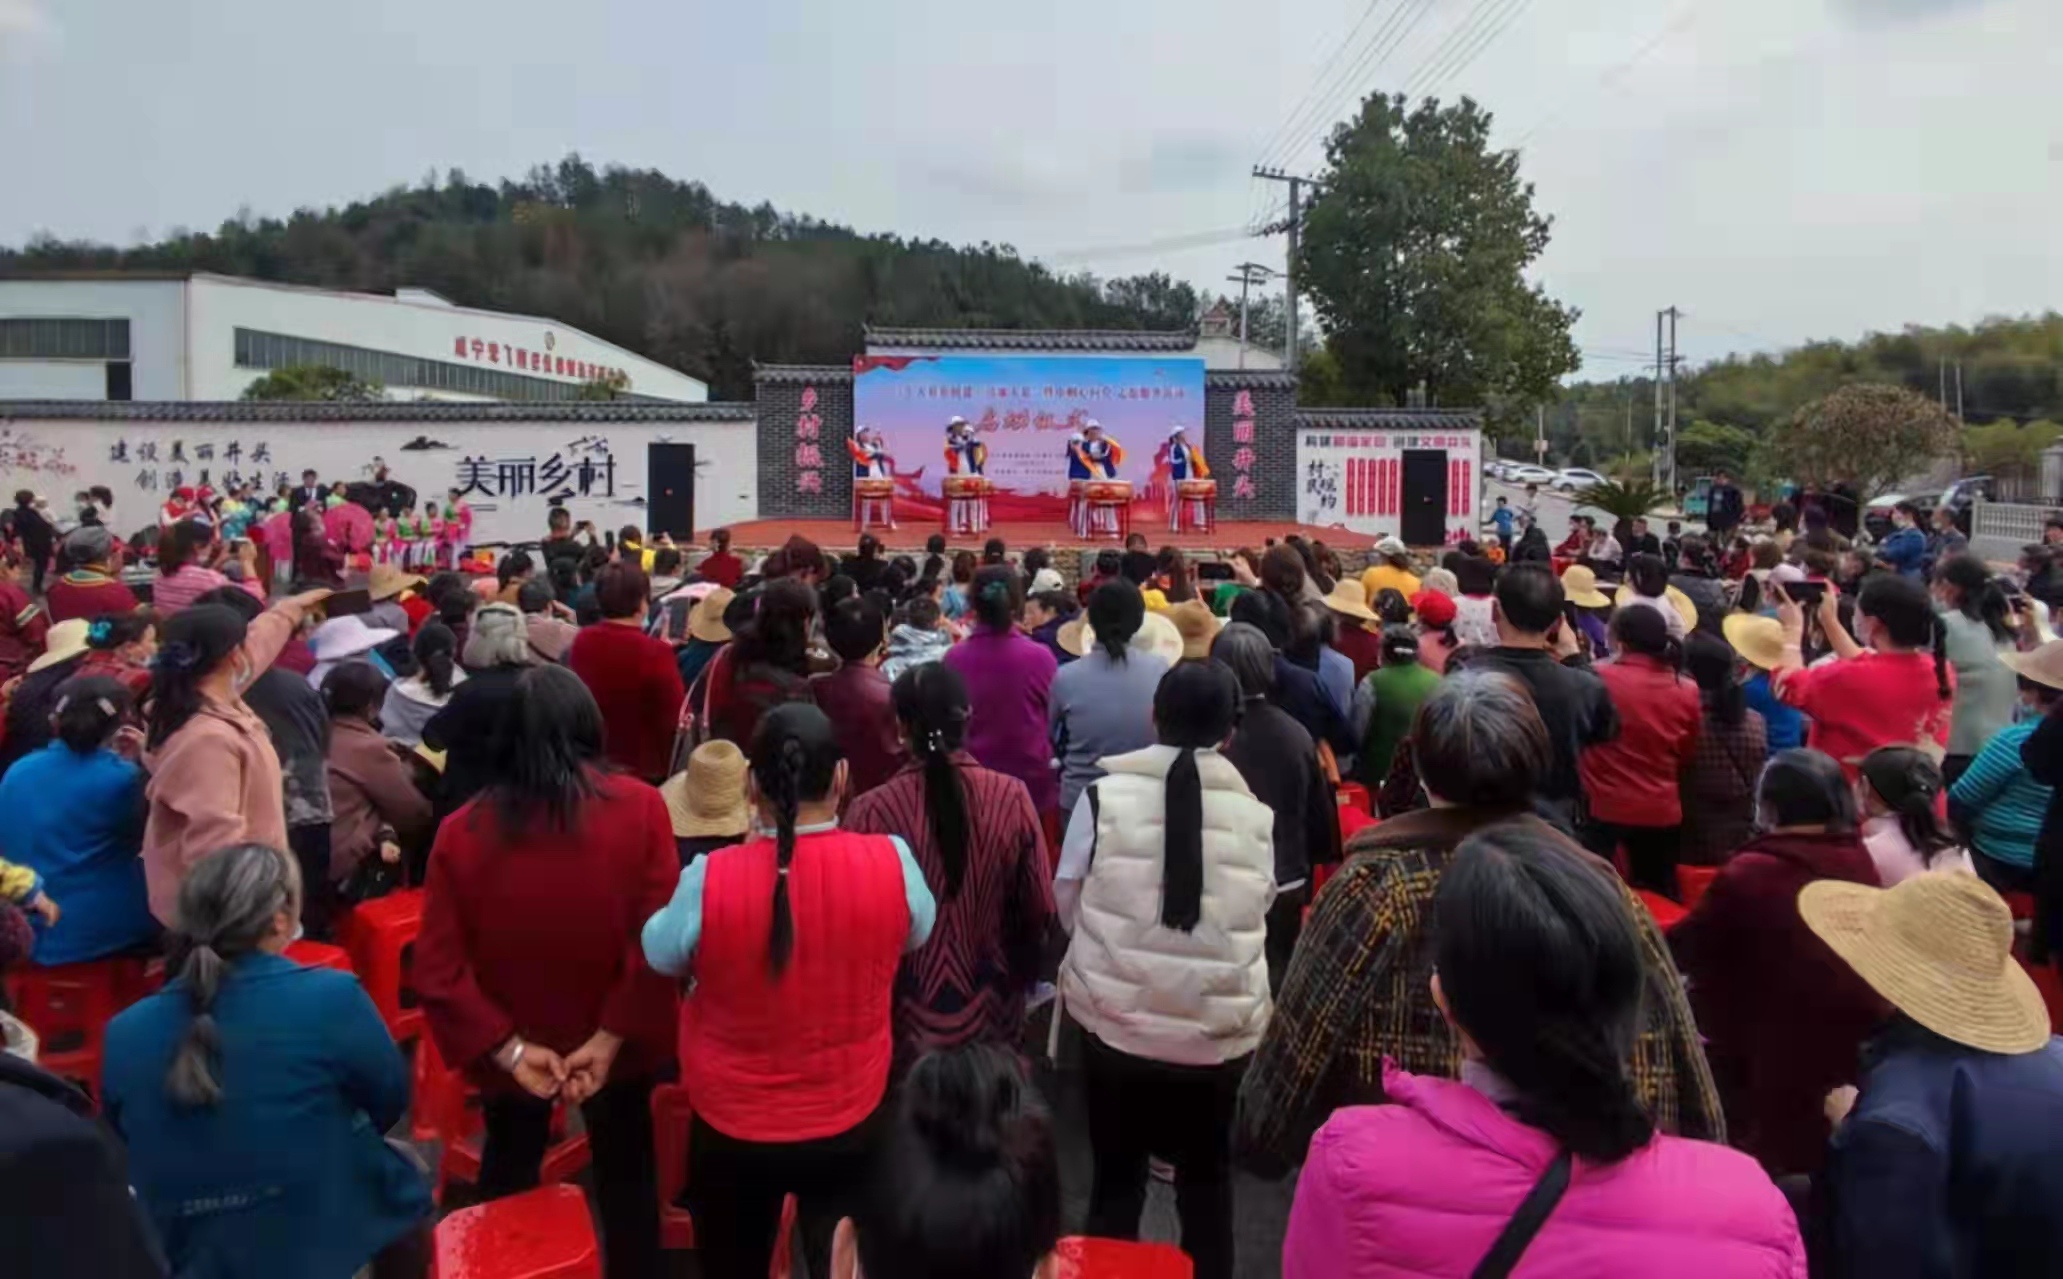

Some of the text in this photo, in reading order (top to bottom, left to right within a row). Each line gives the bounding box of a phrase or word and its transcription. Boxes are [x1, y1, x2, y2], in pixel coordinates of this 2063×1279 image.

[108, 438, 271, 465] 建设美丽井头
[1231, 389, 1257, 500] 美丽井头
[456, 452, 617, 503] 美丽乡村
